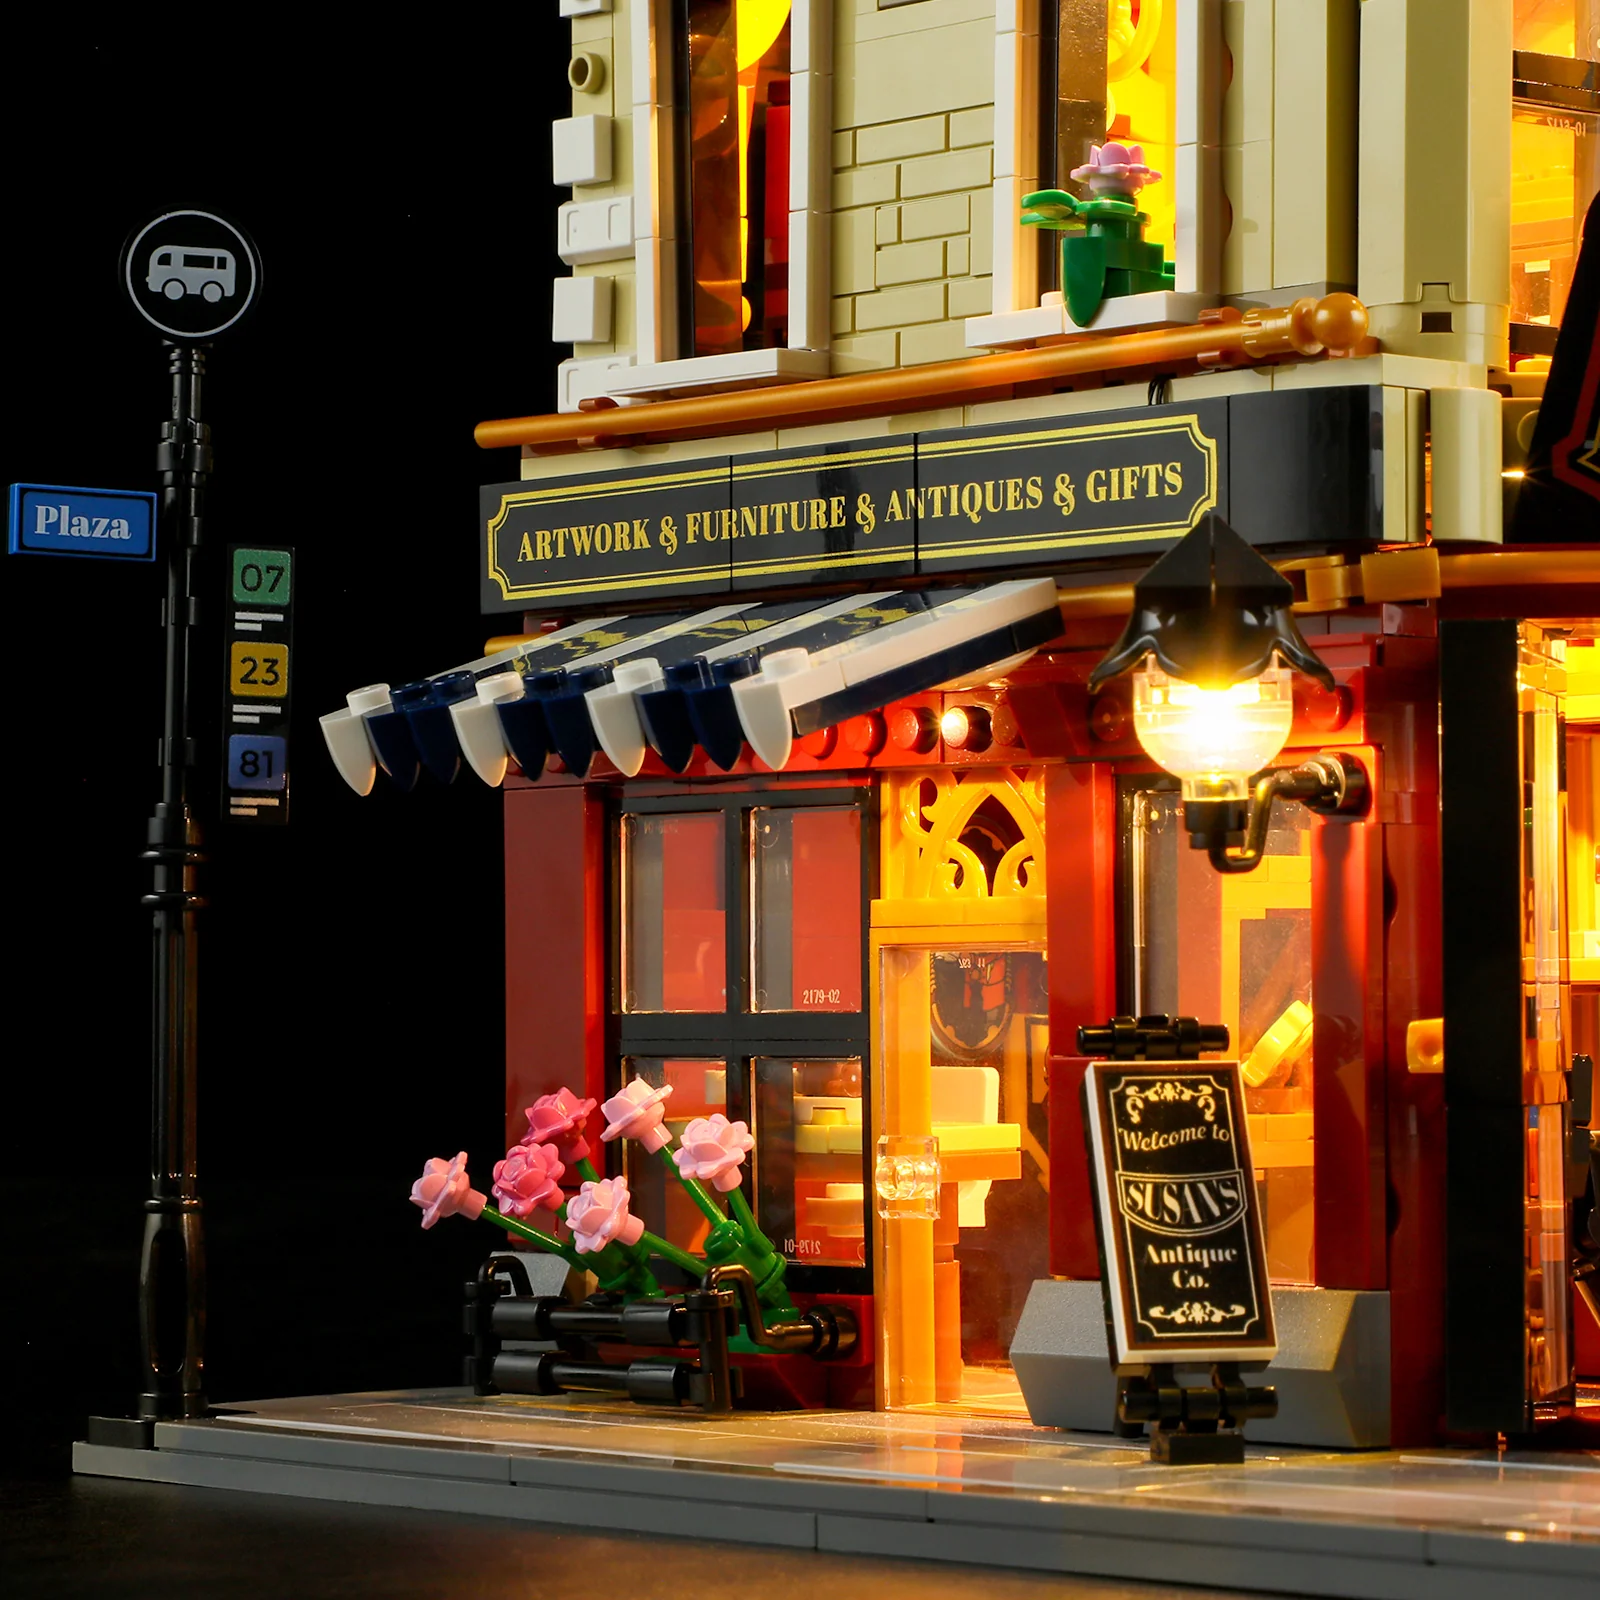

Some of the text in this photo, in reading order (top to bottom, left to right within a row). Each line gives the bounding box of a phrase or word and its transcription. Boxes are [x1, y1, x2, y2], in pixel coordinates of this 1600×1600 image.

[34, 504, 132, 540] Plaza
[517, 461, 1183, 562] ARTWORK & FURNITURE & ANTIQUES & GIFTS
[240, 564, 285, 593] 07
[239, 656, 281, 686] 23
[239, 750, 273, 779] 81
[802, 988, 841, 1005] 2179-02
[1118, 1123, 1230, 1151] Welcome to
[1145, 1243, 1238, 1269] Antique
[1171, 1268, 1210, 1289] Co.
